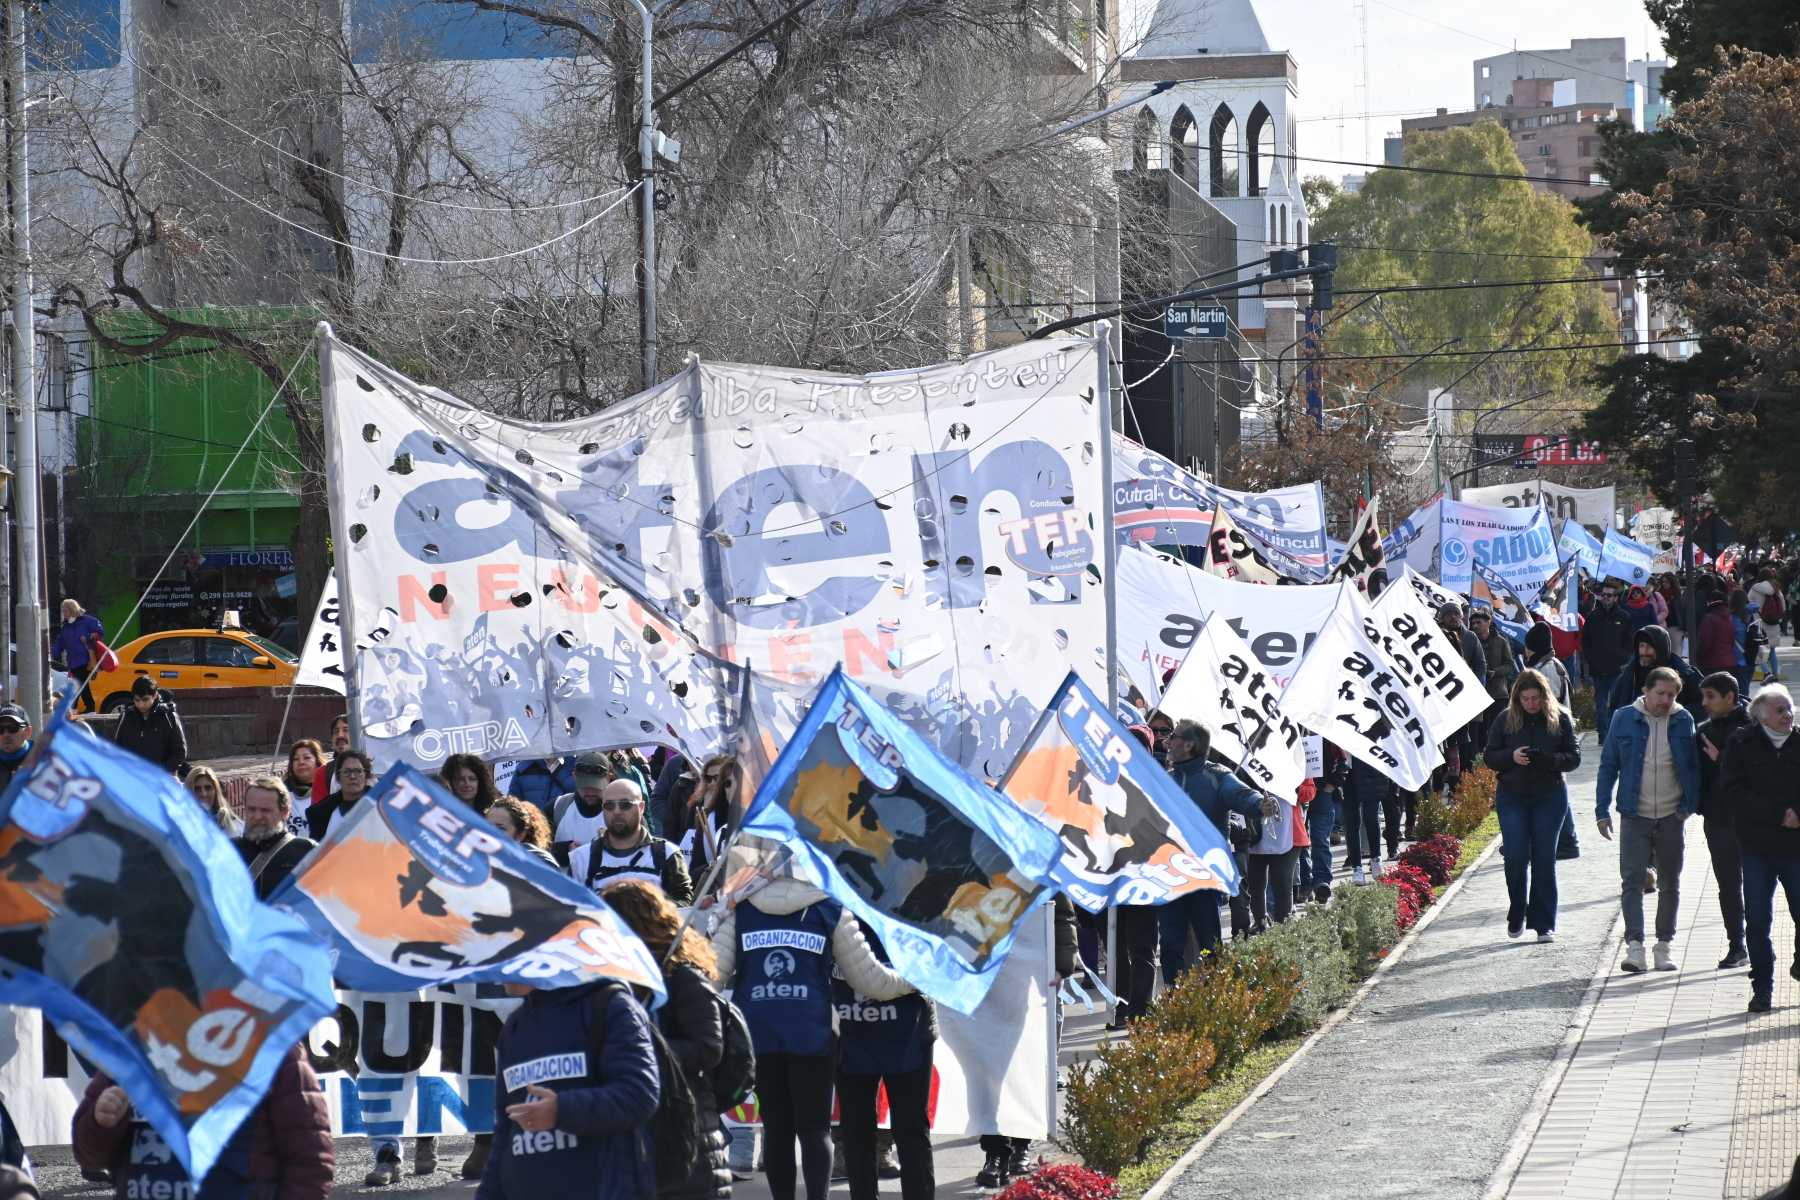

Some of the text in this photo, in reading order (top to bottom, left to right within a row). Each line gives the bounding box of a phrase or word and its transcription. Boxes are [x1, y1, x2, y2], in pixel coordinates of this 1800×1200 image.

[1167, 308, 1188, 323] San
[998, 509, 1086, 556] TEP
[1392, 613, 1464, 702] aten
[1063, 685, 1132, 765] TEP
[1220, 654, 1298, 750] aten
[1343, 651, 1425, 749] aten
[414, 718, 531, 762] CTERA
[838, 701, 905, 772] TEP
[29, 756, 102, 809] EP
[388, 776, 503, 859] TEP
[744, 930, 824, 954] ORGANIZACION
[751, 981, 808, 999] aten
[838, 1003, 897, 1022] aten
[320, 1076, 498, 1136] EN
[512, 1129, 578, 1156] aten
